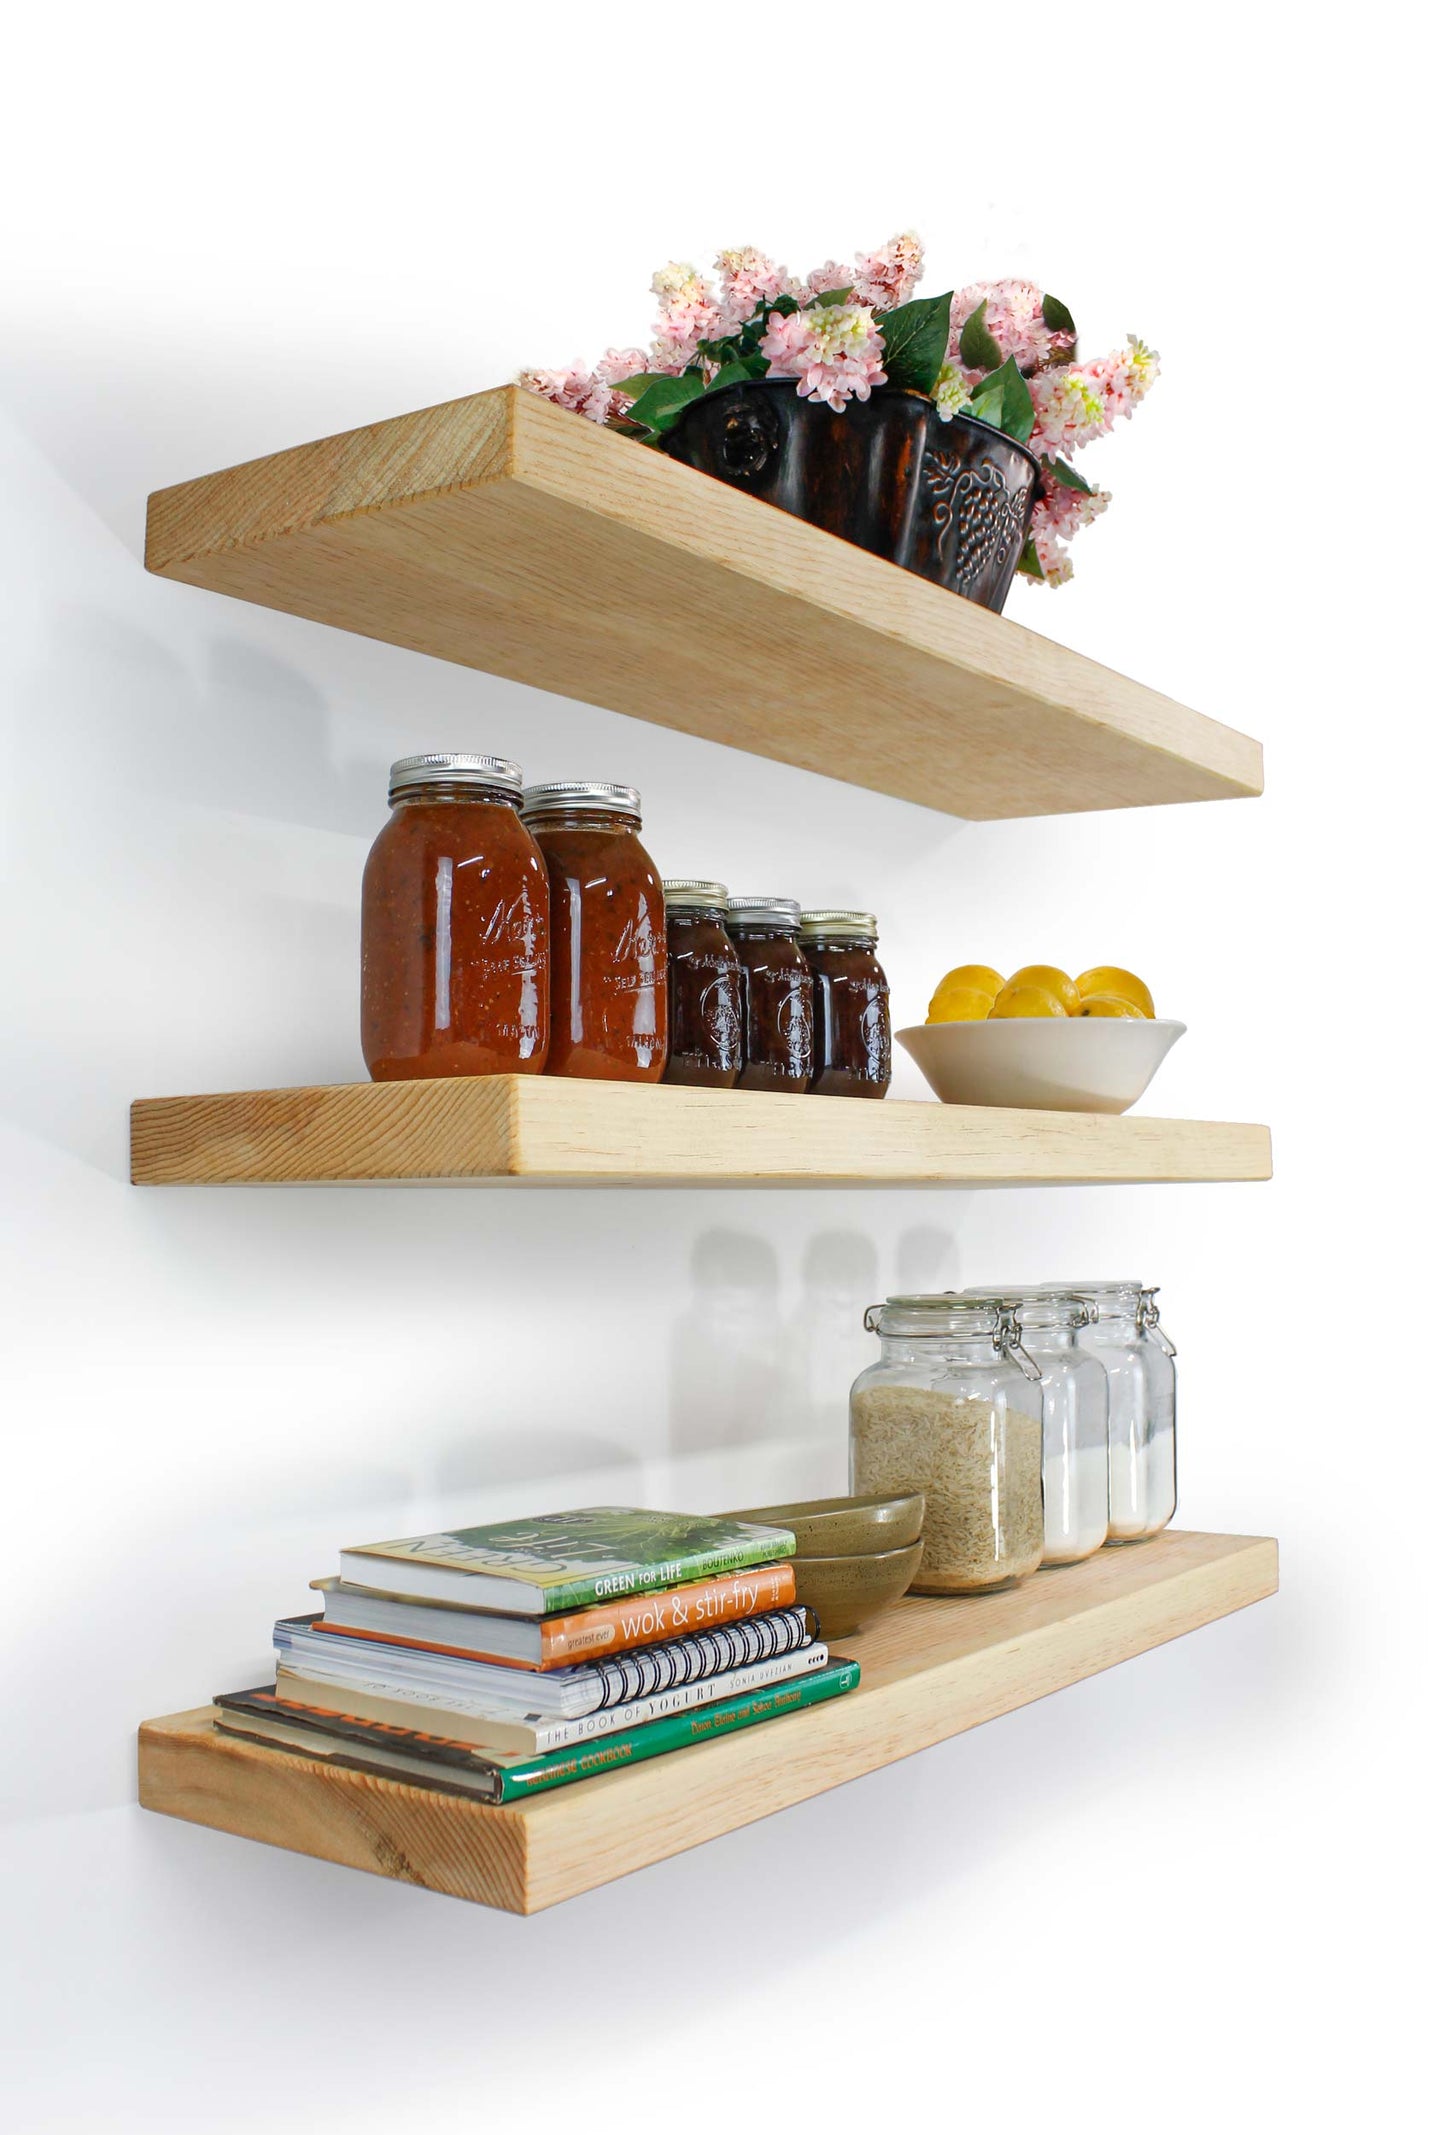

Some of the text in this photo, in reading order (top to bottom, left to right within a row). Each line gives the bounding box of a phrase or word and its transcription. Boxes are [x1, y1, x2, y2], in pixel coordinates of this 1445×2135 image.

[595, 1551, 744, 1597] GREEN FOR LIFE BOUTENKO
[621, 1601, 665, 1641] wok
[672, 1596, 689, 1626] &
[696, 1580, 759, 1620] stir-fry
[567, 1629, 610, 1650] greatest ever
[547, 1663, 793, 1745] THE BOOK OF YOGURT SONIA UVEZIAN
[581, 1743, 633, 1770] COOKBOOK
